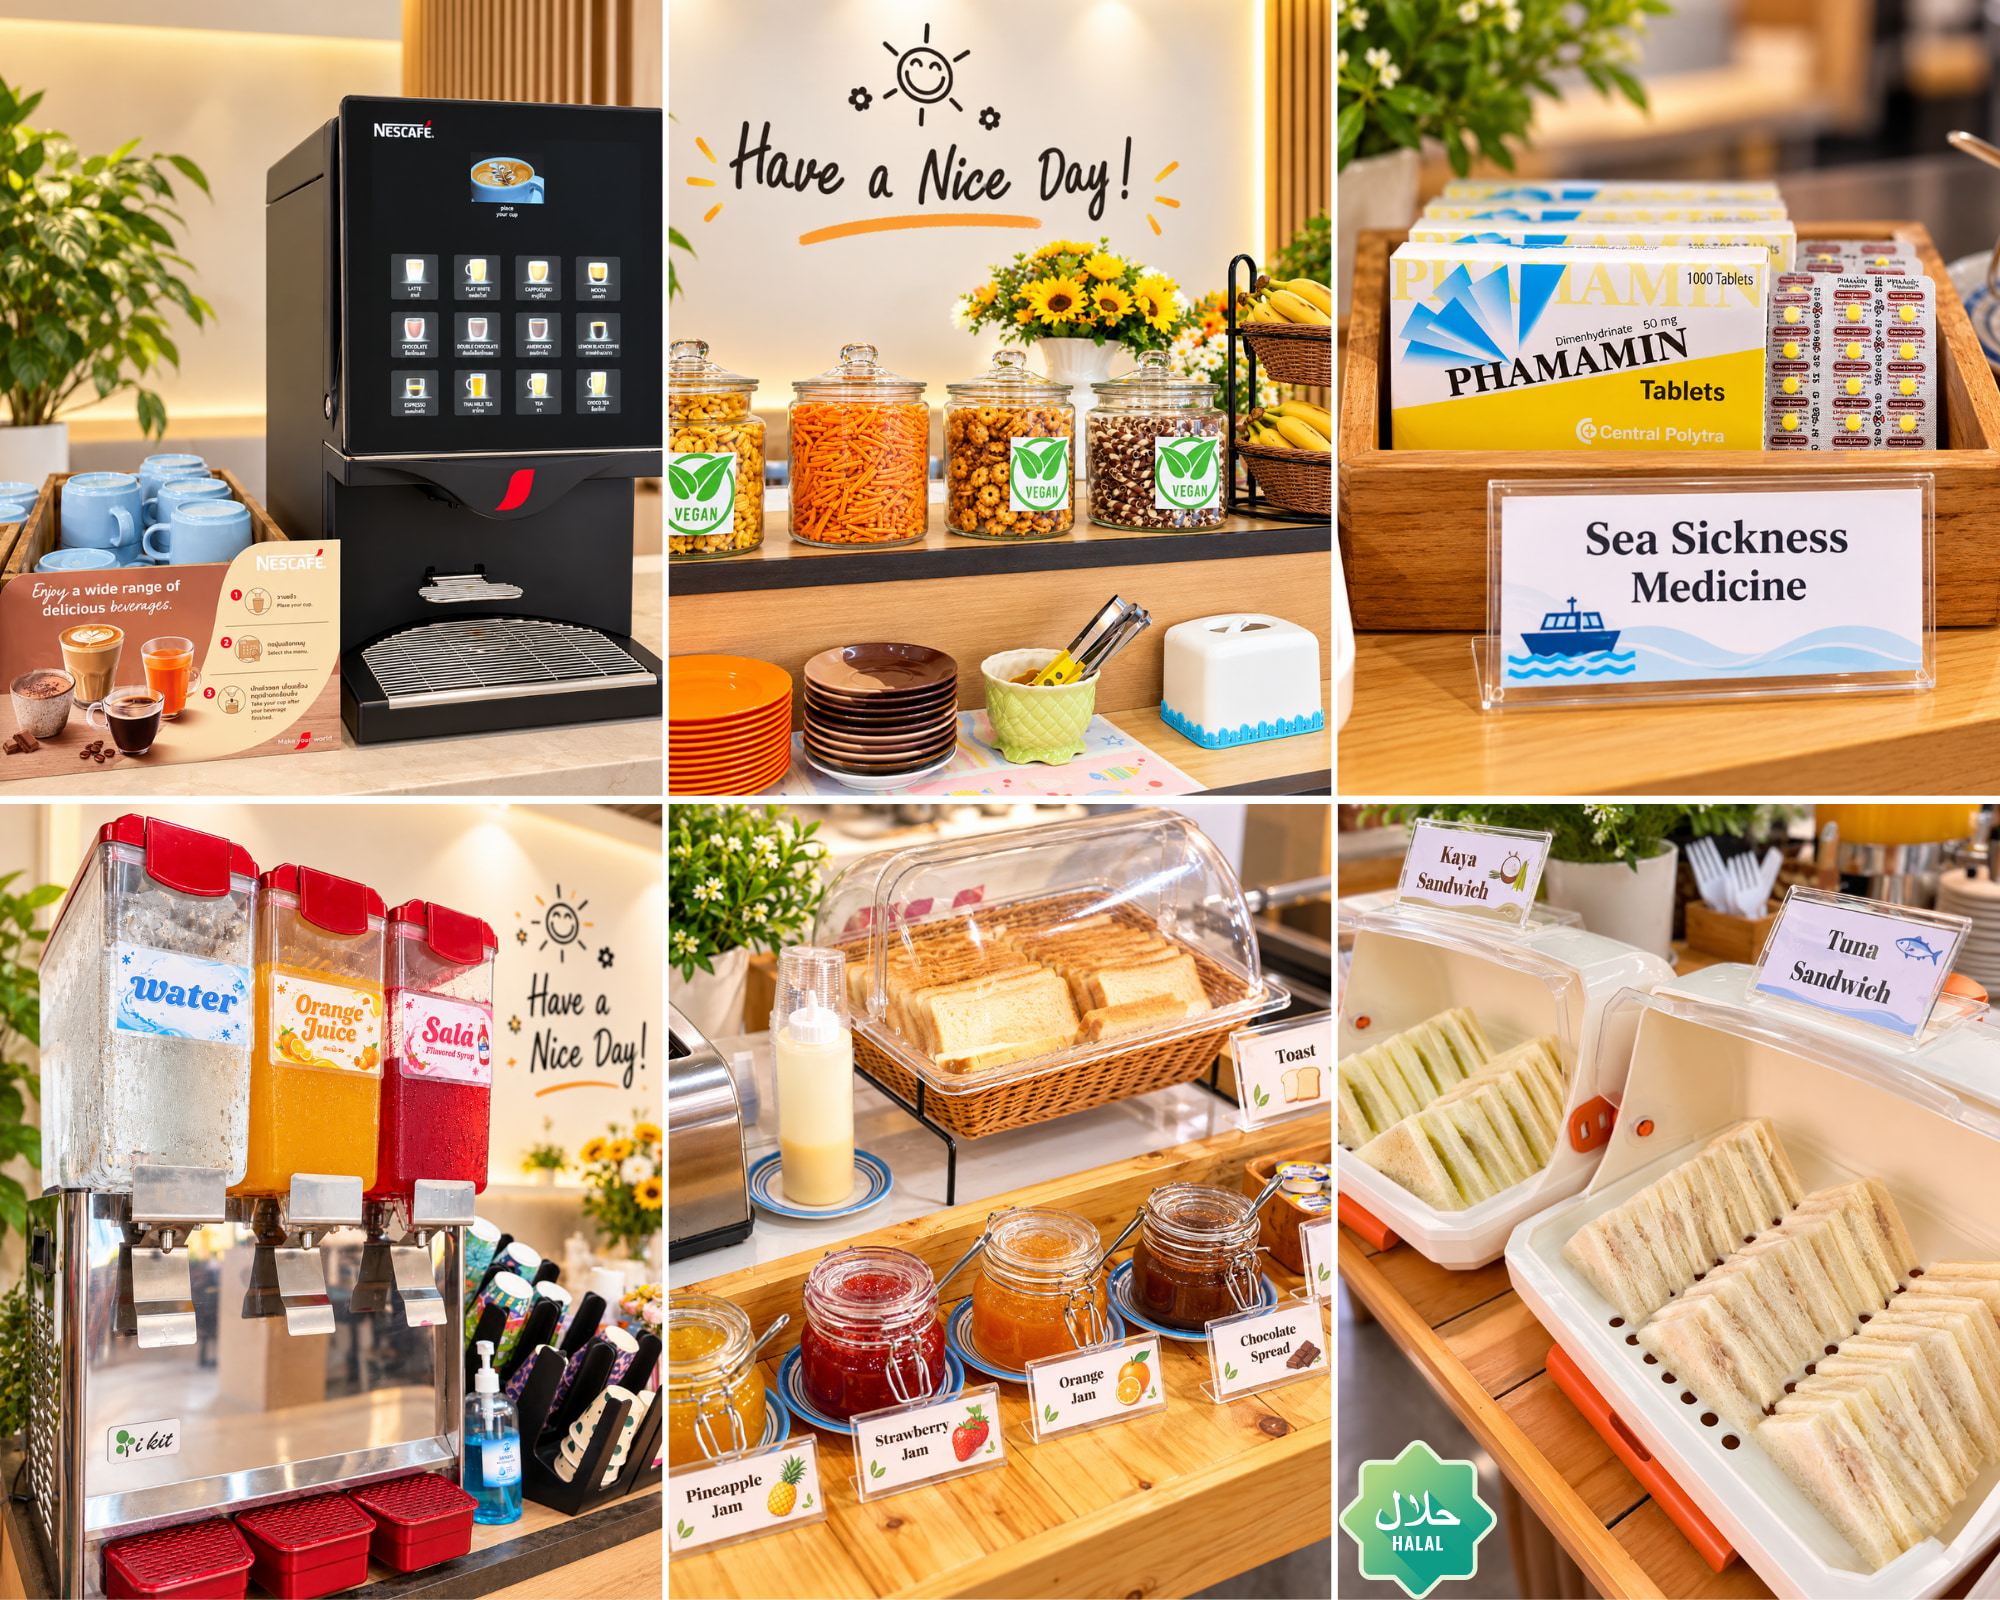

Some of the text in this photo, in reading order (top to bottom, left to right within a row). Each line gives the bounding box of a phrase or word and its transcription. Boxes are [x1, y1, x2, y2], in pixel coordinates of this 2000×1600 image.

[729, 120, 845, 195] Have
[868, 164, 894, 199] a
[918, 144, 1012, 205] Nice
[1688, 272, 1754, 286] 1000 Tablets
[1555, 316, 1678, 347] Dimenhydrinate 50 mg
[1445, 327, 1688, 398] PHAMAMIN
[1640, 380, 1726, 401] Tablets
[1600, 425, 1725, 446] Central Polytra
[1026, 486, 1058, 499] VEGAN
[1172, 484, 1208, 498] VEGAN
[674, 507, 718, 522] VEGAN
[1586, 520, 1849, 556] Sea Sickness
[32, 580, 181, 604] Enjoy a wide range of
[1632, 569, 1807, 604] Medicine
[42, 599, 173, 617] delicious beverages.
[206, 689, 212, 697] 3
[1440, 844, 1478, 871] Kaya
[1416, 872, 1490, 902] Sandwich
[1826, 928, 1880, 961] Tuna
[129, 973, 240, 1017] Water
[527, 972, 611, 1018] Have a
[1788, 960, 1892, 1005] Sandwich
[295, 994, 364, 1026] Orange
[301, 1016, 358, 1042] Juice
[457, 1050, 475, 1062] Syrup
[530, 1021, 646, 1090] Nice Day!
[1275, 1044, 1316, 1064] Toast
[1240, 1322, 1297, 1349] Chocolate
[1250, 1340, 1292, 1364] Spread
[1058, 1367, 1106, 1392] Orange
[1070, 1386, 1098, 1406] Jam
[146, 1431, 174, 1450] kit
[875, 1417, 951, 1449] Strawberry
[900, 1441, 930, 1463] Jam
[684, 1472, 763, 1506] Pineapple
[711, 1498, 744, 1521] Jam
